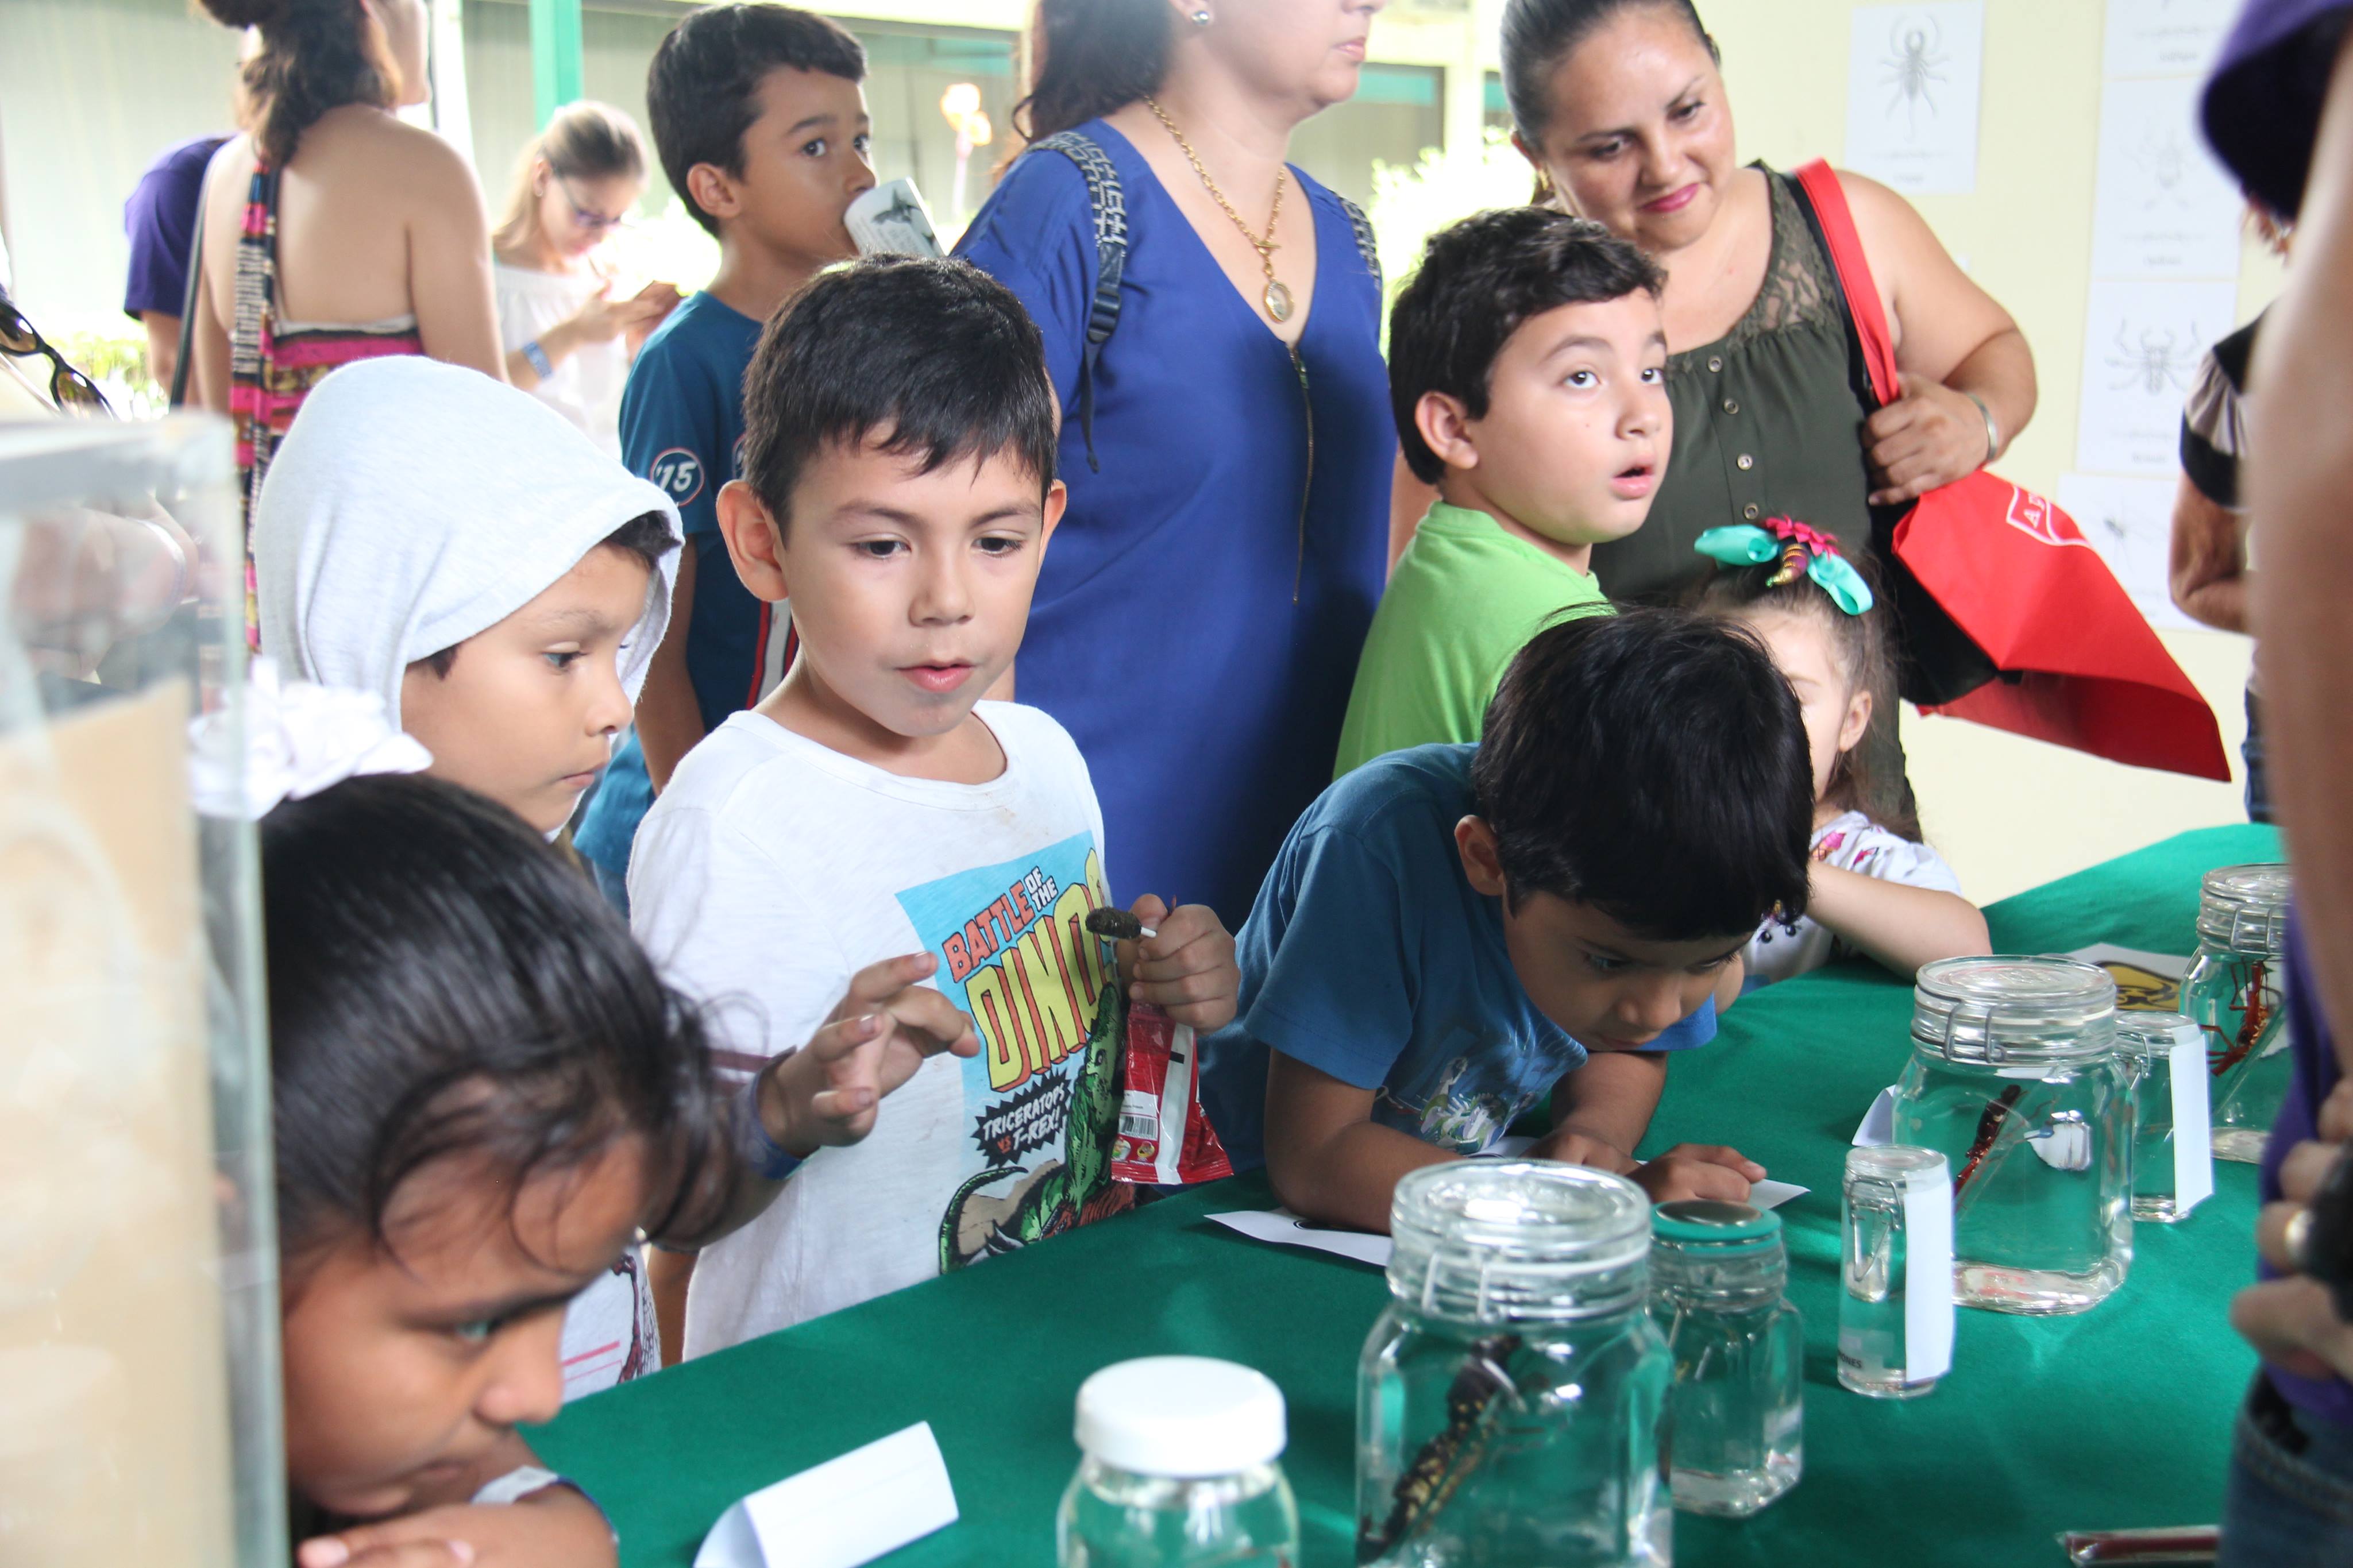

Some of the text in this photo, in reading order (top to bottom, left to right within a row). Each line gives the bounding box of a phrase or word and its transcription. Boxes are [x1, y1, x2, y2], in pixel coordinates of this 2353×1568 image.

[1024, 866, 1043, 894] OF
[1031, 875, 1058, 912] THE
[942, 880, 1035, 983] BATTLE
[982, 1082, 1064, 1141] TRICERATOPS
[1013, 1105, 1060, 1150] T-REX!
